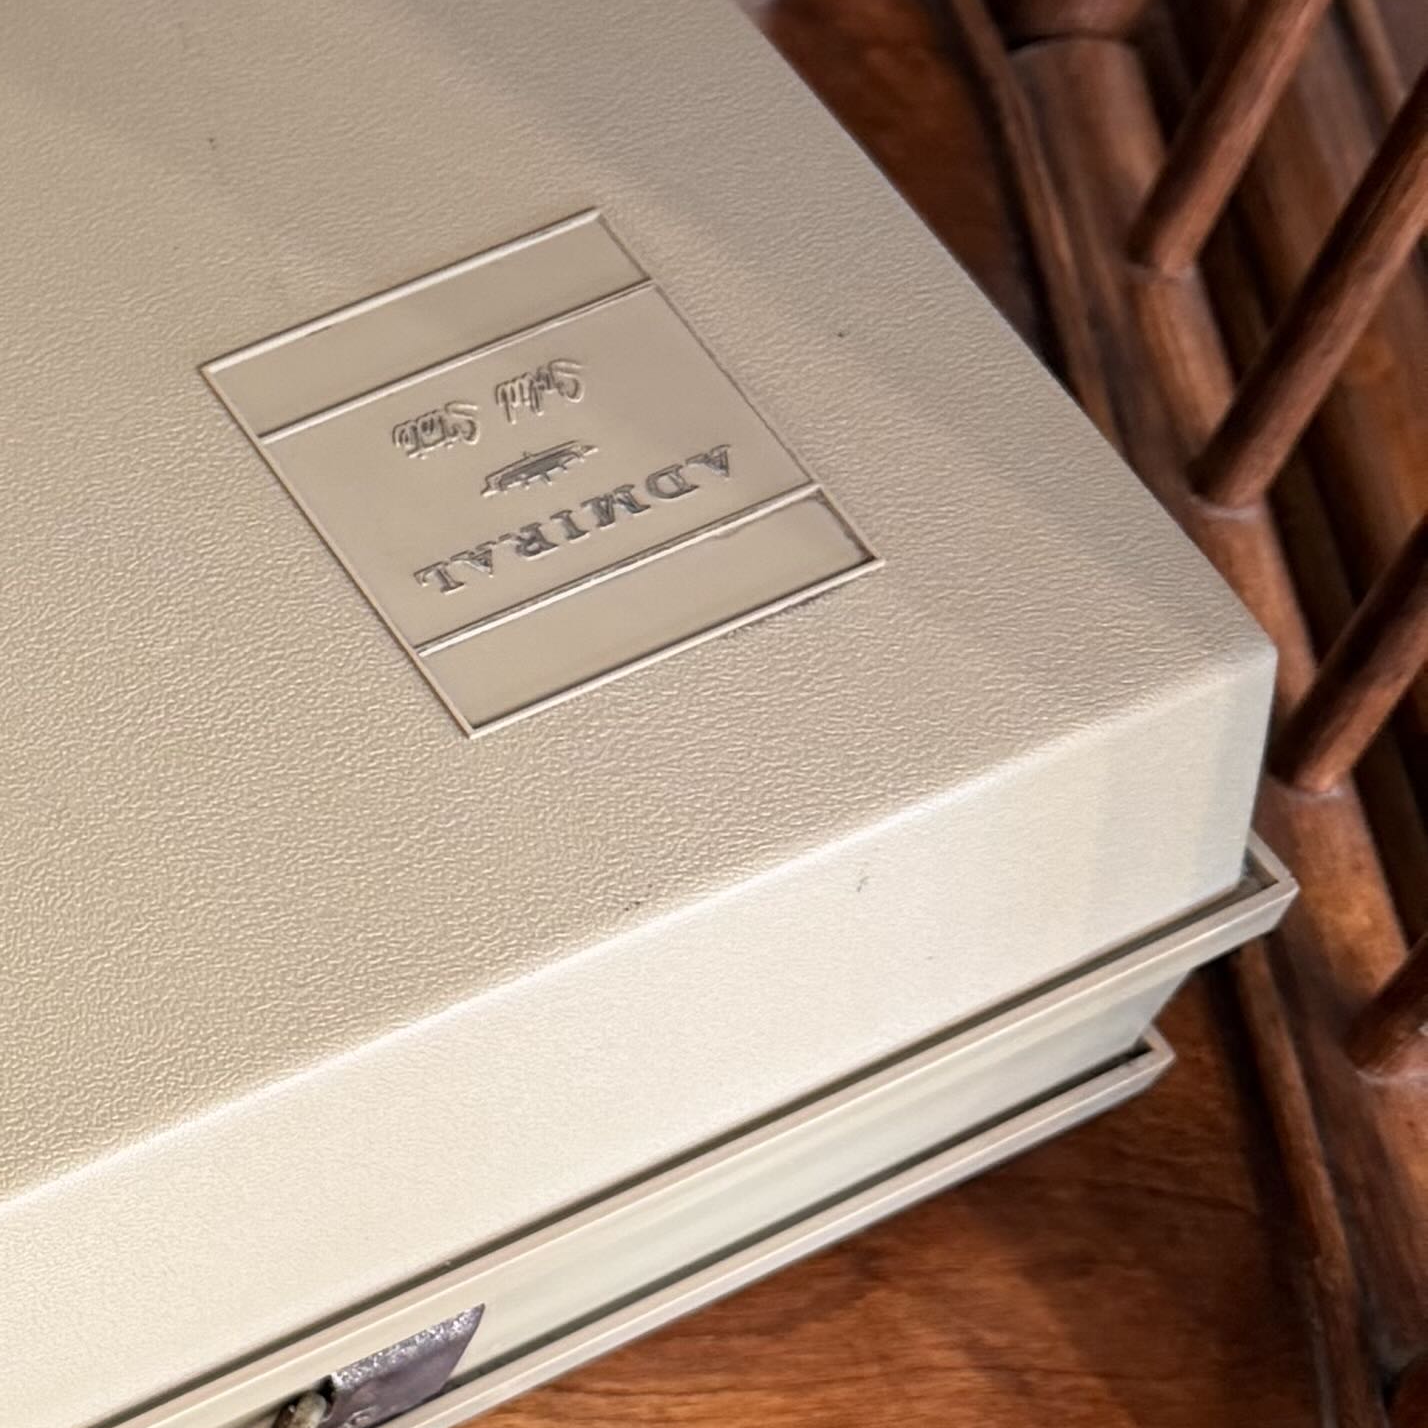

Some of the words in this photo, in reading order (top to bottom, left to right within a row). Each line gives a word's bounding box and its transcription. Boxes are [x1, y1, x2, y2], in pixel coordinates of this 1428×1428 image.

[494, 358, 585, 424] Solid
[392, 400, 479, 460] State
[413, 444, 731, 595] ADMIRAL
